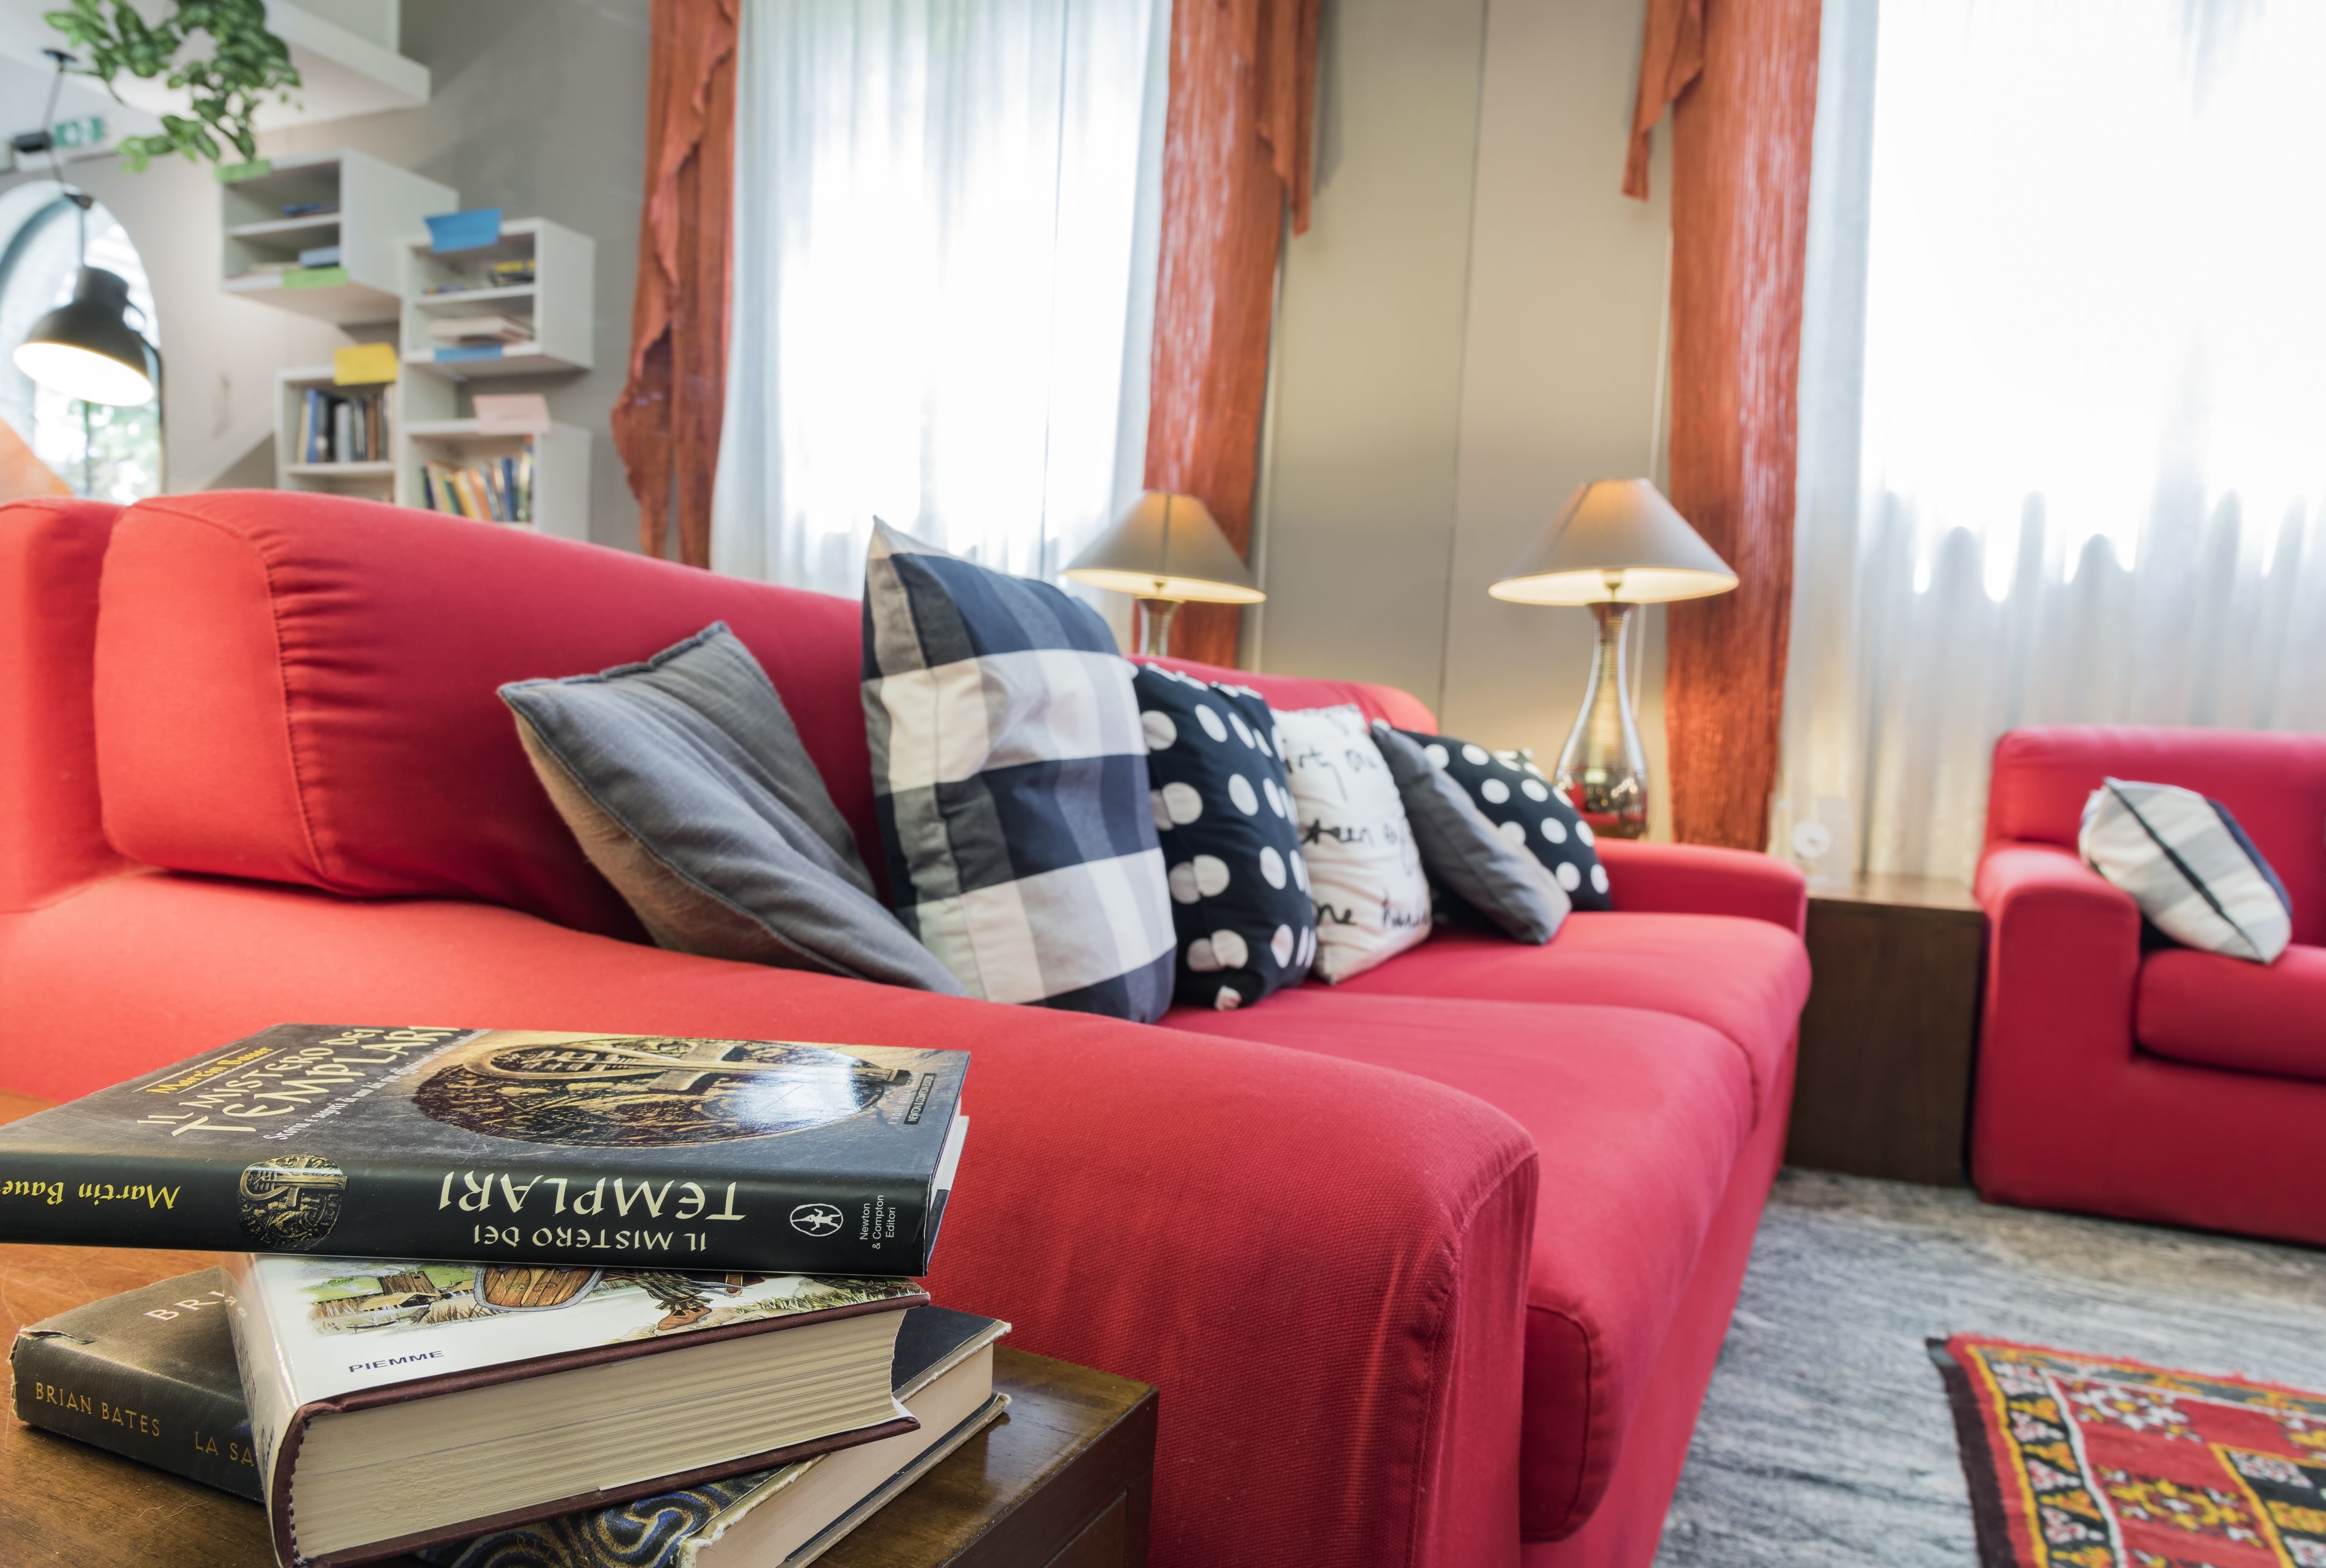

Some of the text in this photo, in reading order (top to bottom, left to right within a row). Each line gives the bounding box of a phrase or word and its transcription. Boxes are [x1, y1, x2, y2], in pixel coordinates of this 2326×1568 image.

[136, 1028, 385, 1125] IL MISTERO DEI
[146, 1067, 228, 1094] Martin
[171, 1025, 462, 1137] TEMPLARI
[907, 1105, 922, 1122] NEWTON
[915, 1087, 930, 1102] COMPTON
[262, 1123, 311, 1140] Storia
[0, 1180, 181, 1209] Martin Baue
[439, 1170, 747, 1220] TEMPLARI
[859, 1203, 870, 1240] Newton
[872, 1195, 884, 1240] Compton
[885, 1207, 896, 1238] Editori
[474, 1224, 707, 1252] IL MISTERO DEI
[348, 1350, 445, 1373] PIEMME
[35, 1381, 92, 1415] BRIAN
[101, 1401, 161, 1437] BATES
[194, 1431, 219, 1456] LA
